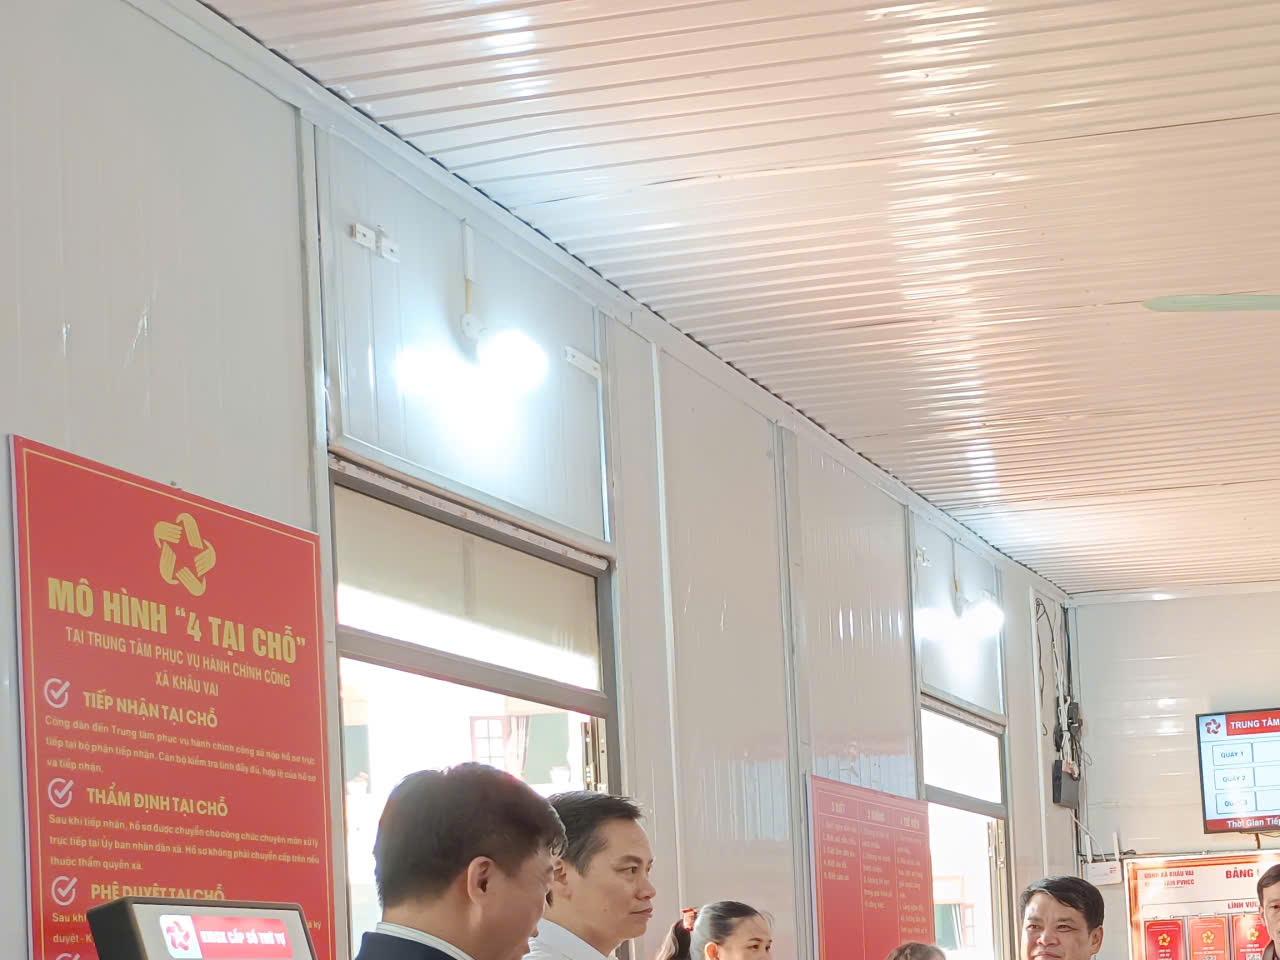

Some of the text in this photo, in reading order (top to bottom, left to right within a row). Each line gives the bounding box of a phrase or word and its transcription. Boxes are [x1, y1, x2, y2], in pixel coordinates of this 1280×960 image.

[48, 577, 94, 617] MÔ
[103, 588, 167, 634] HÌNH
[208, 616, 245, 656] TẠI
[88, 631, 127, 653] TRUNG
[129, 638, 152, 658] TÂM
[155, 645, 184, 667] PHỤC
[187, 652, 200, 671] VỤ
[203, 654, 230, 675] HÀNH
[232, 661, 262, 681] CHÍNH
[264, 667, 291, 688] CÔNG
[155, 669, 219, 697] XÃ KHÂU VAI
[83, 689, 218, 729] TIẾP NHẬN TẠI CHỖ
[1230, 720, 1260, 730] TRUNG
[1262, 717, 1280, 727] TÂM
[86, 782, 228, 817] THẨM ĐỊNH TẠI CHỖ
[1225, 867, 1254, 879] BẢNG
